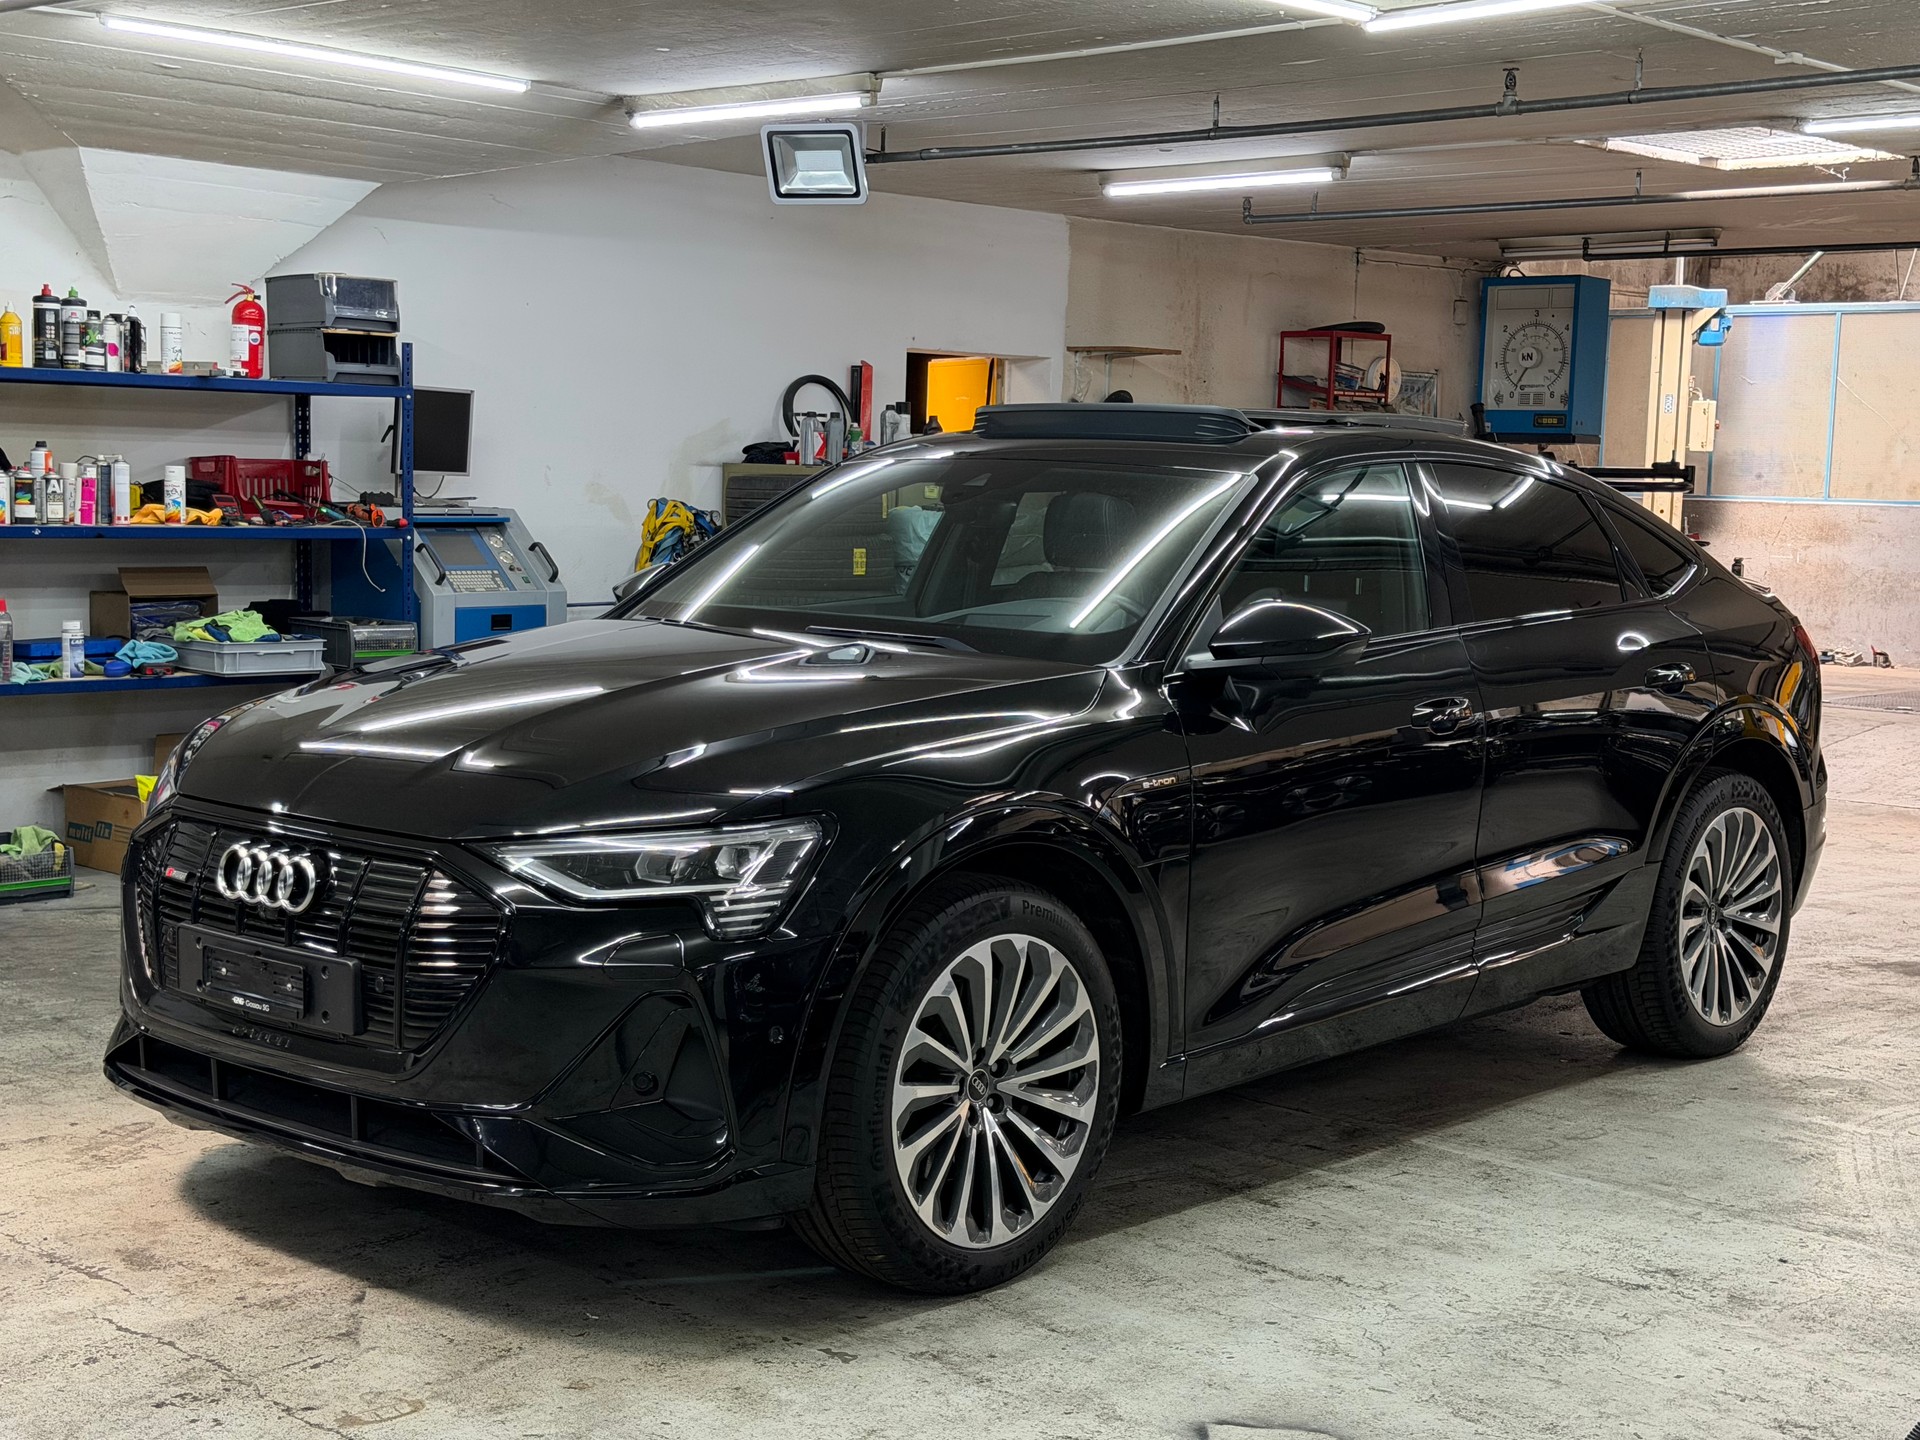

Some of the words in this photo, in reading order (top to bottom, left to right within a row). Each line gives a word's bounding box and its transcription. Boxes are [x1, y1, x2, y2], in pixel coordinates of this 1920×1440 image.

[1502, 325, 1509, 333] 2
[1564, 324, 1570, 332] 4
[1521, 352, 1533, 361] kN
[1549, 390, 1555, 398] 6
[1142, 776, 1176, 789] e-tron
[1674, 795, 1721, 880] PremiumContact
[1721, 789, 1726, 801] 6
